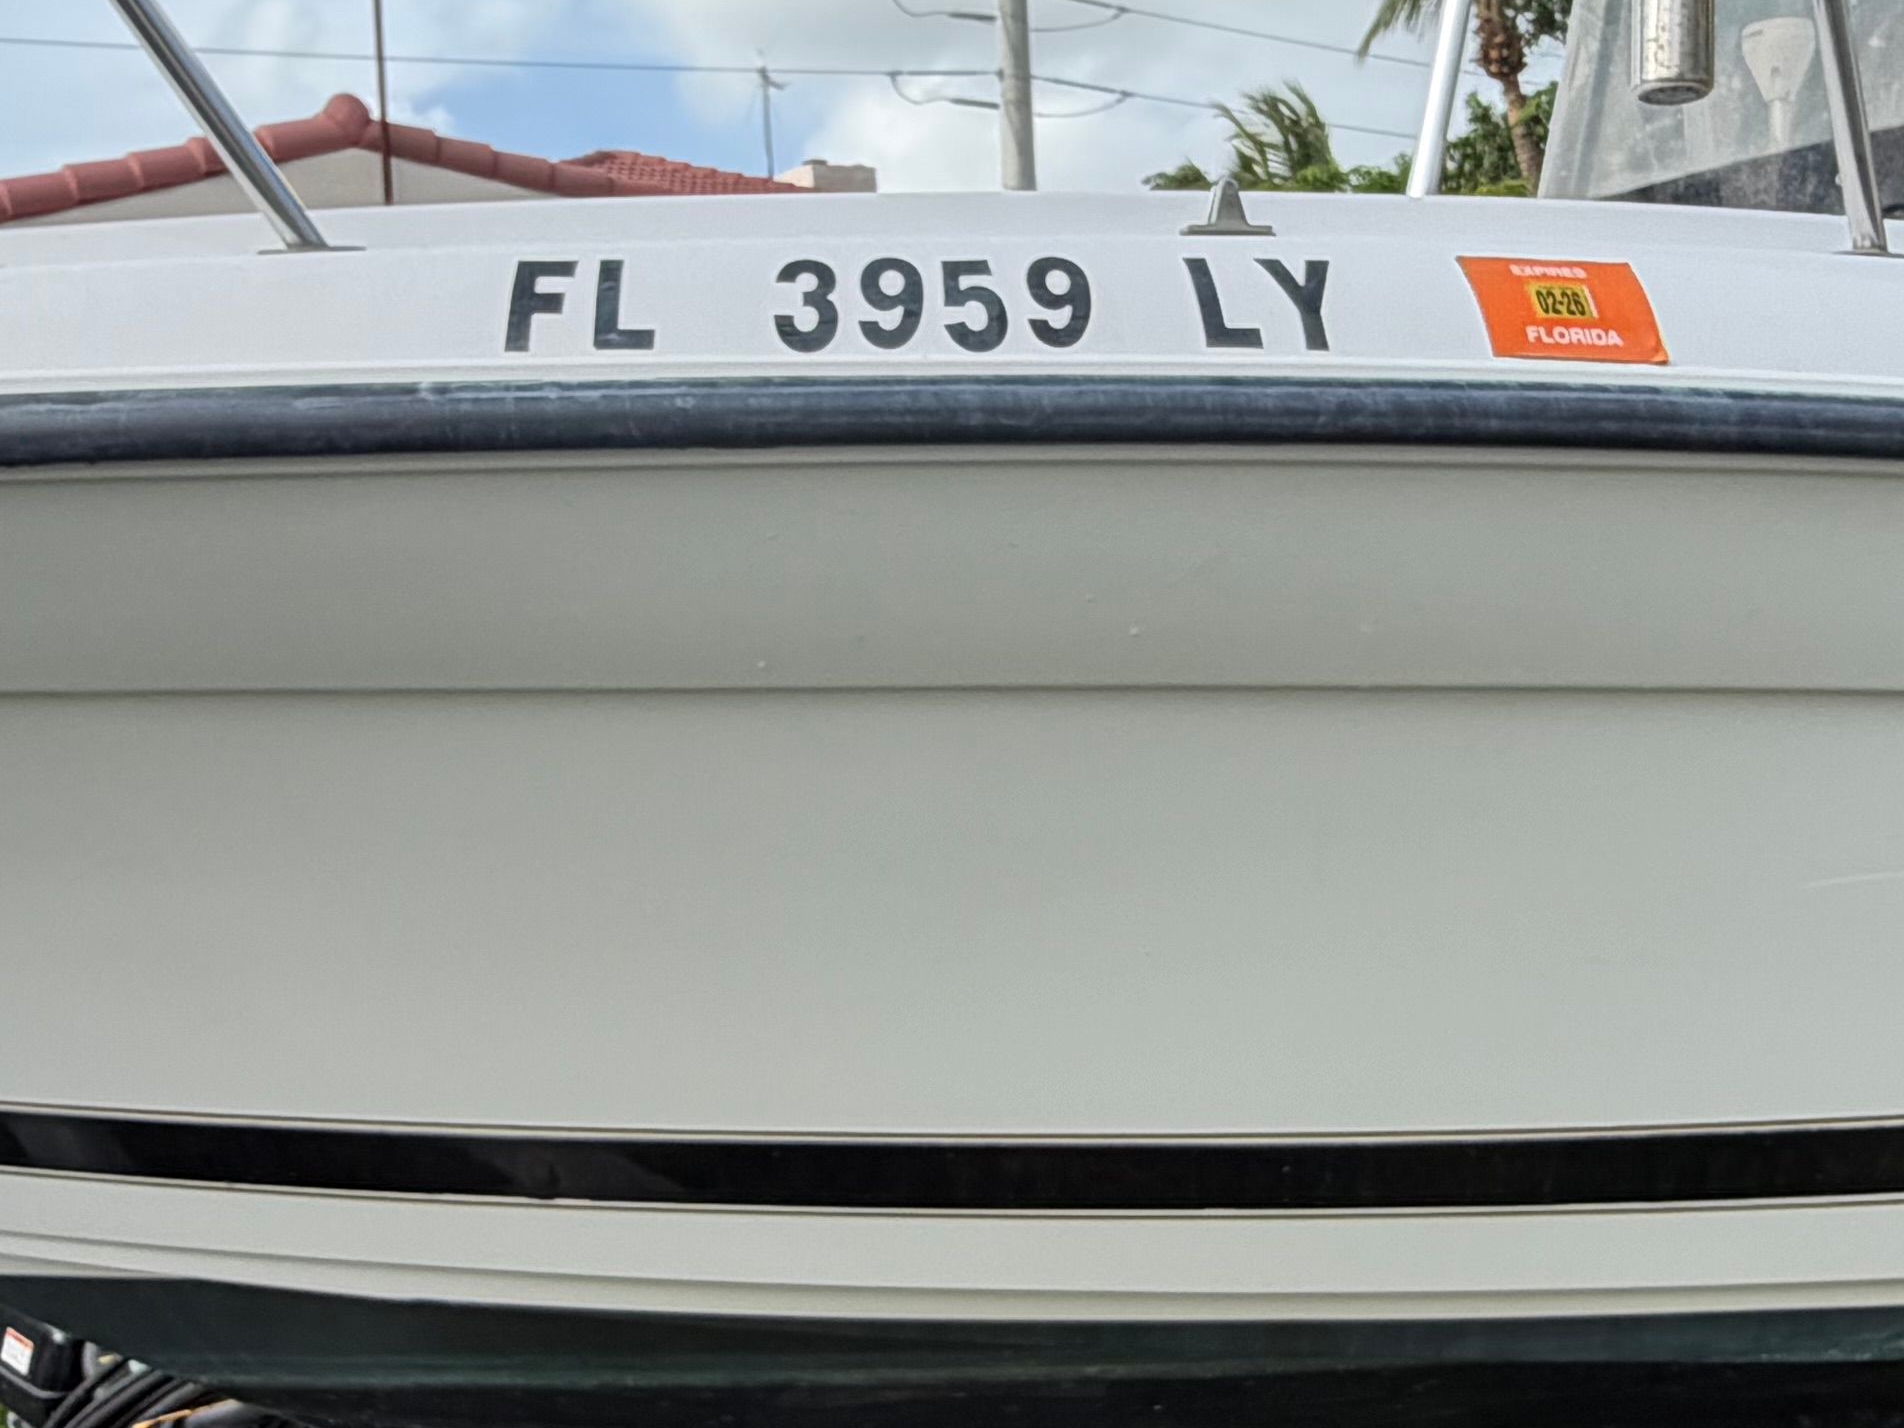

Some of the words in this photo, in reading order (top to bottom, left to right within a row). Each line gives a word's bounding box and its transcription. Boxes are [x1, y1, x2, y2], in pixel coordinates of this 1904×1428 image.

[1509, 263, 1588, 280] EXPIRES
[504, 259, 656, 352] FL
[772, 256, 1093, 353] 3959
[1181, 257, 1330, 352] LY
[1535, 289, 1587, 317] 02-26
[1525, 325, 1625, 348] FLORIDA
